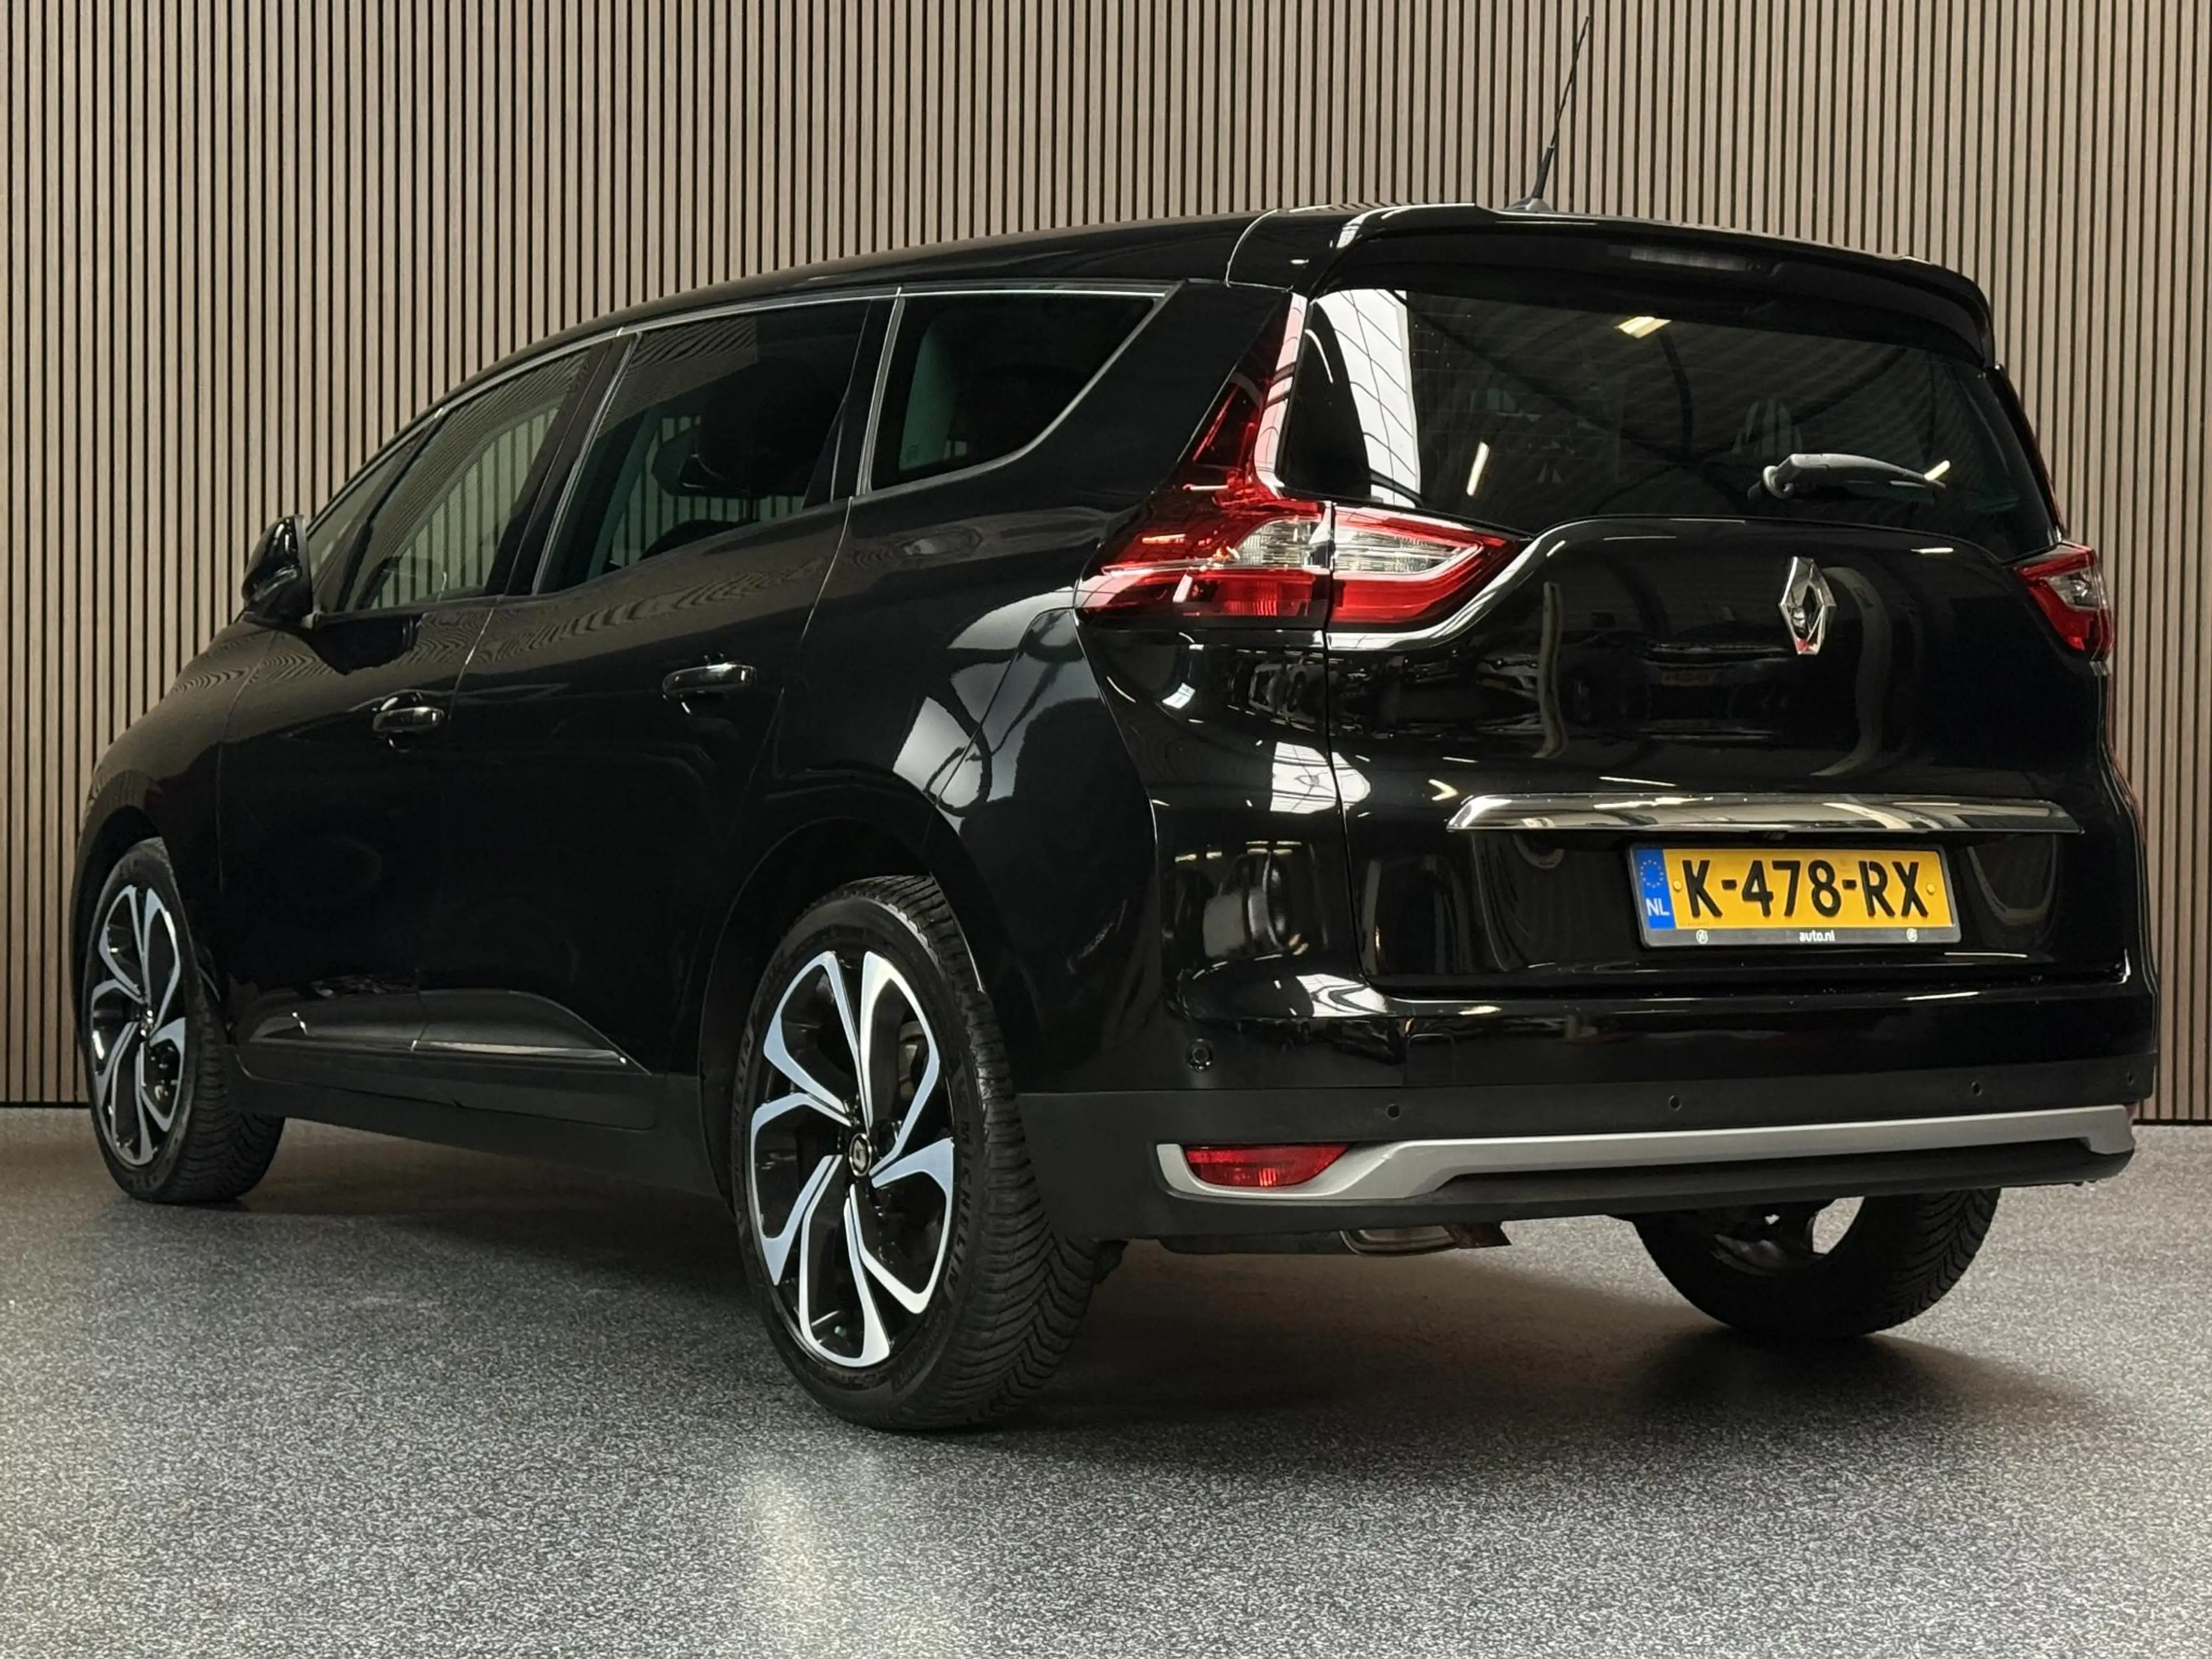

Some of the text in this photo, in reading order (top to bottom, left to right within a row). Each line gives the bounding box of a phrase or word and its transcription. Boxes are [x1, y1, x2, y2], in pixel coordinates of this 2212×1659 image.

[1646, 897, 1670, 916] NL
[1682, 859, 1928, 918] K-478-RX
[1799, 930, 1835, 942] auto.nl
[948, 1120, 972, 1290] MICHELIN
